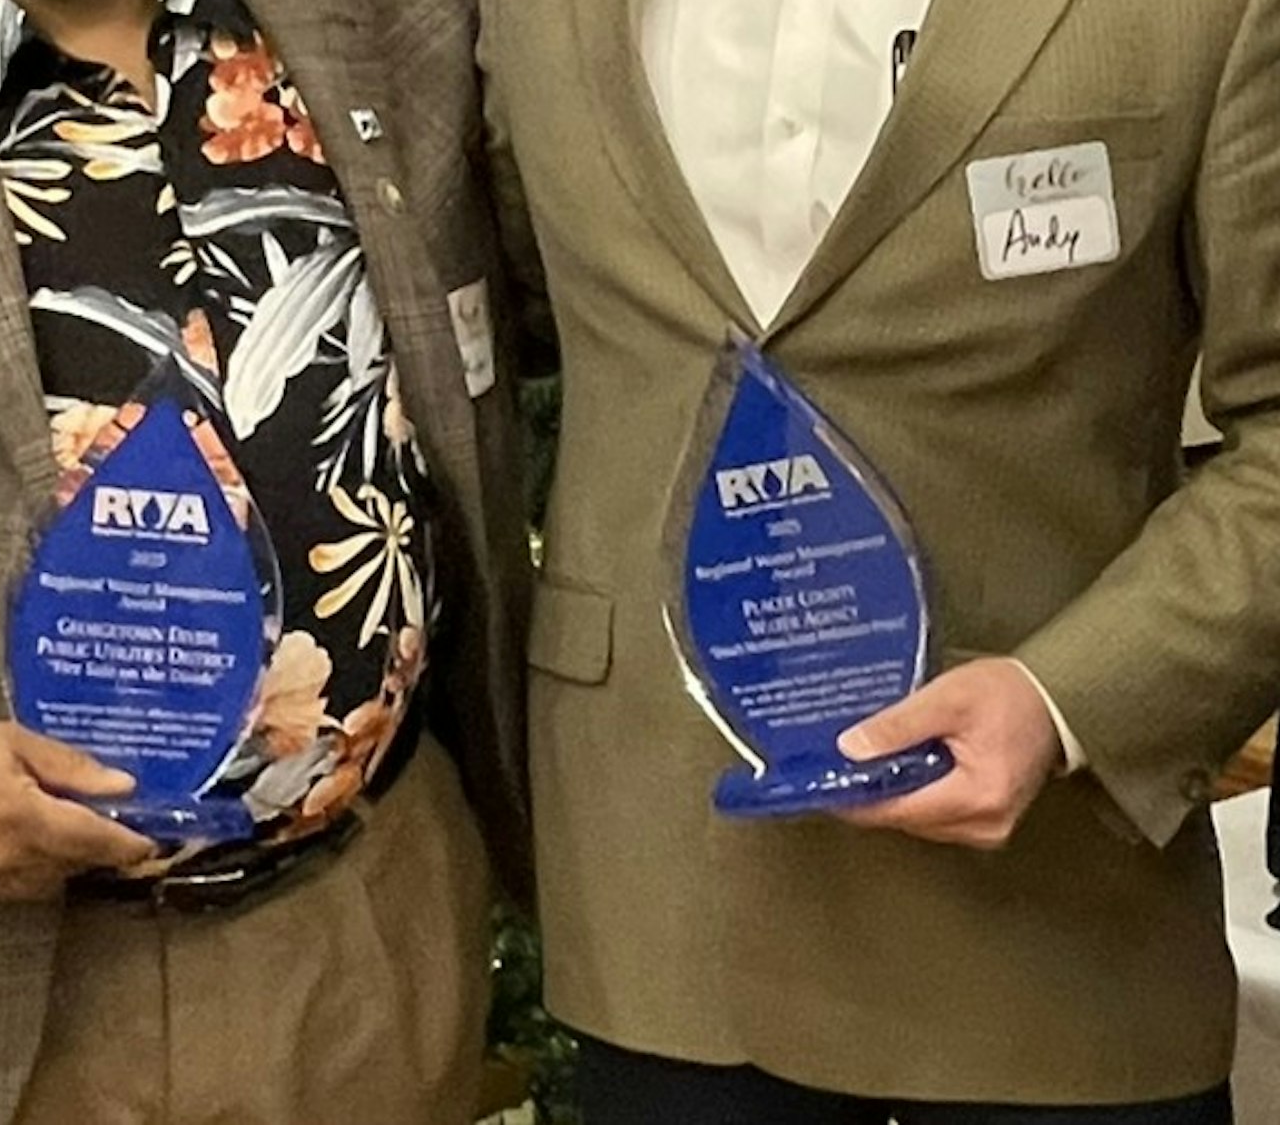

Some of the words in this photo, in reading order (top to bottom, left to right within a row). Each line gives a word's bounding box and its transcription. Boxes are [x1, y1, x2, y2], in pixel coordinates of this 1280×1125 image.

[1003, 208, 1080, 263] Andy
[742, 594, 796, 618] PLACER
[746, 615, 801, 637] WATER
[802, 605, 858, 628] AGENCY
